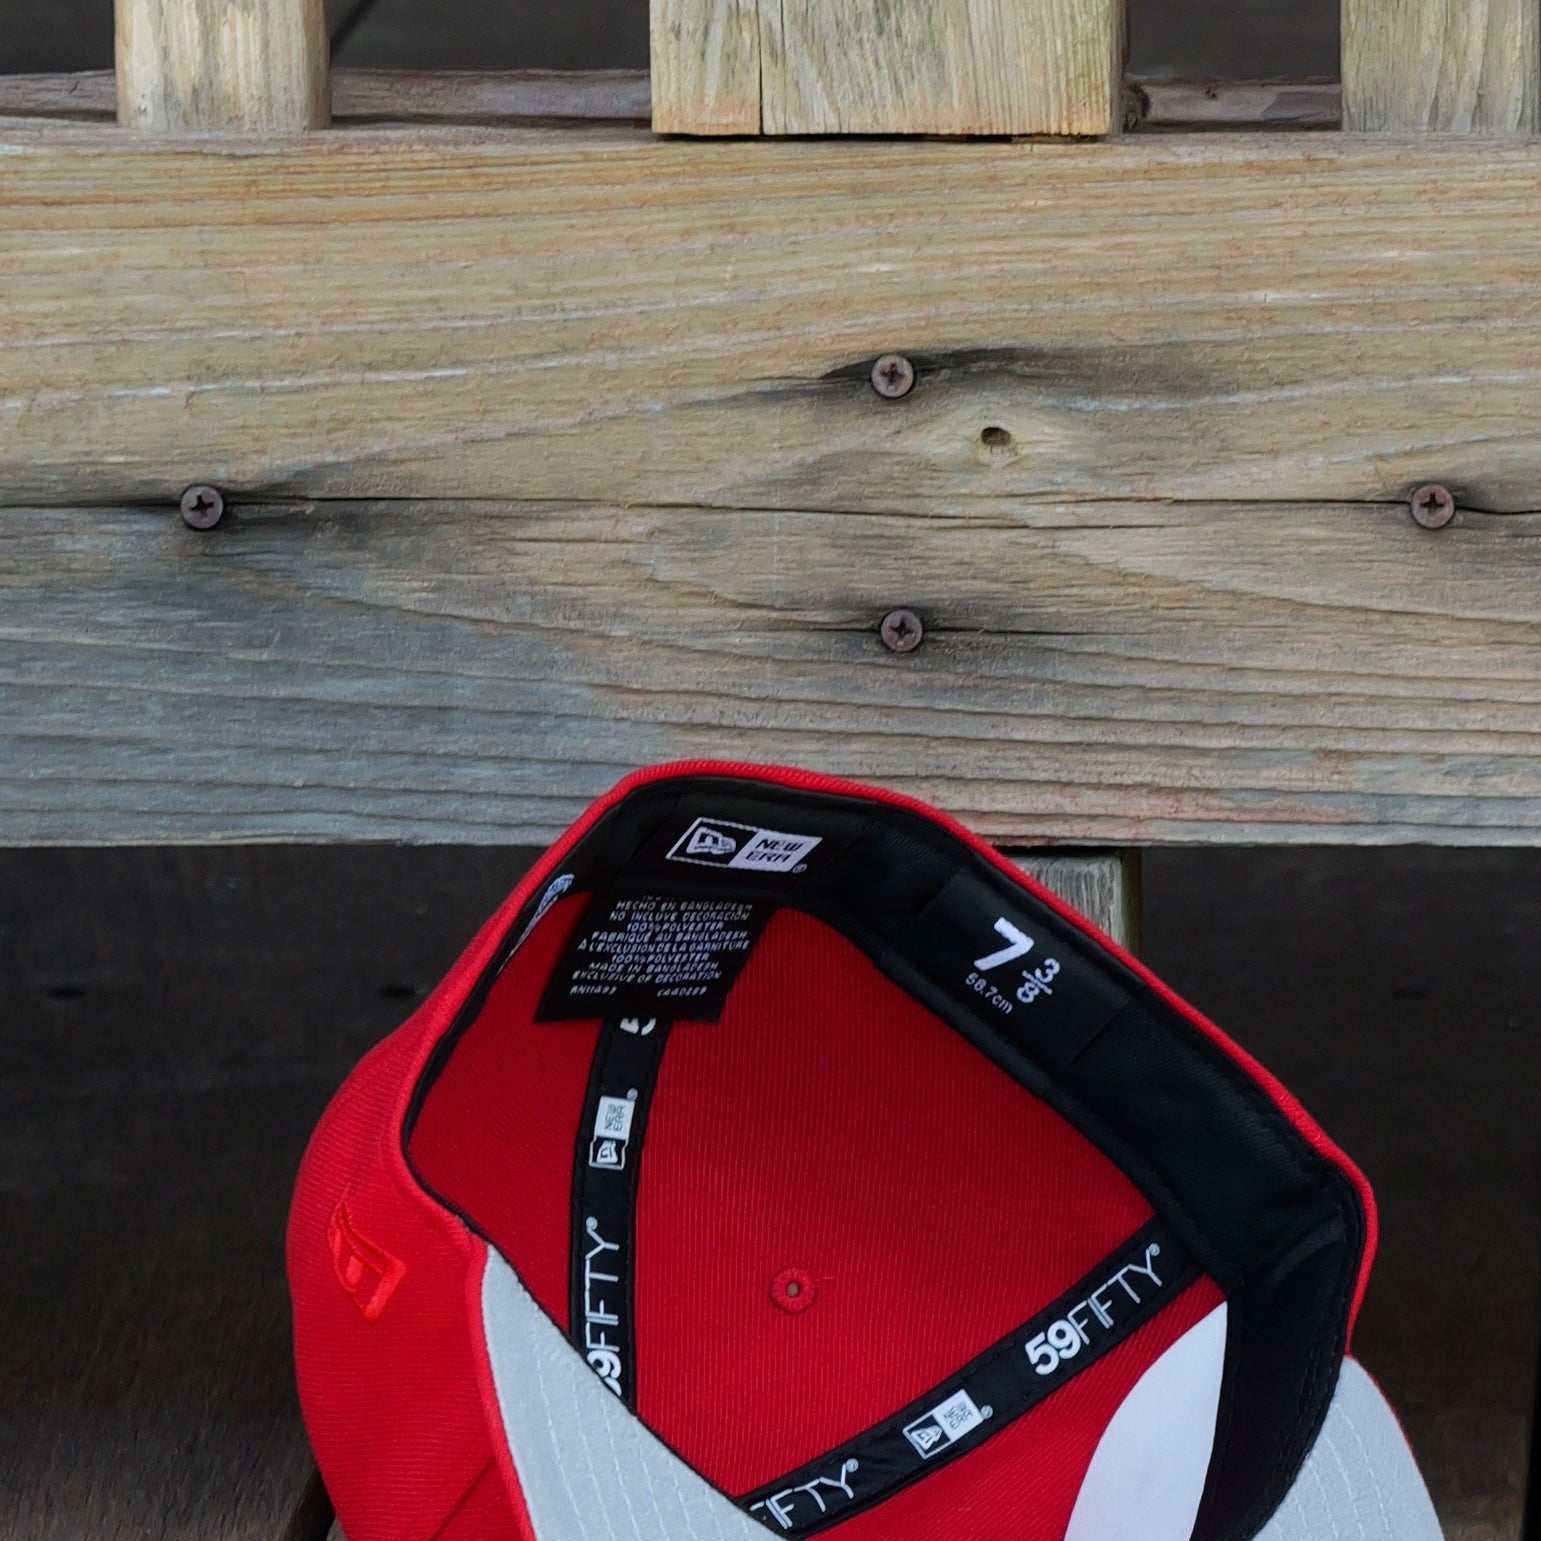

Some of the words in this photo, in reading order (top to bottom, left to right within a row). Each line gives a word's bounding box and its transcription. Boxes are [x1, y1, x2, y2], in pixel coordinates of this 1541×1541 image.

[755, 838, 804, 852] NEW
[745, 851, 793, 864] ERA
[616, 899, 656, 912] HECHO
[660, 901, 677, 911] EN
[680, 900, 753, 912] BANGLADESH
[609, 911, 626, 921] NO
[974, 916, 1035, 972] 7
[588, 962, 625, 972] MADE
[628, 963, 642, 973] IN
[964, 972, 1014, 1015] 58.7cm
[1024, 1247, 1164, 1377] 59FIFTY
